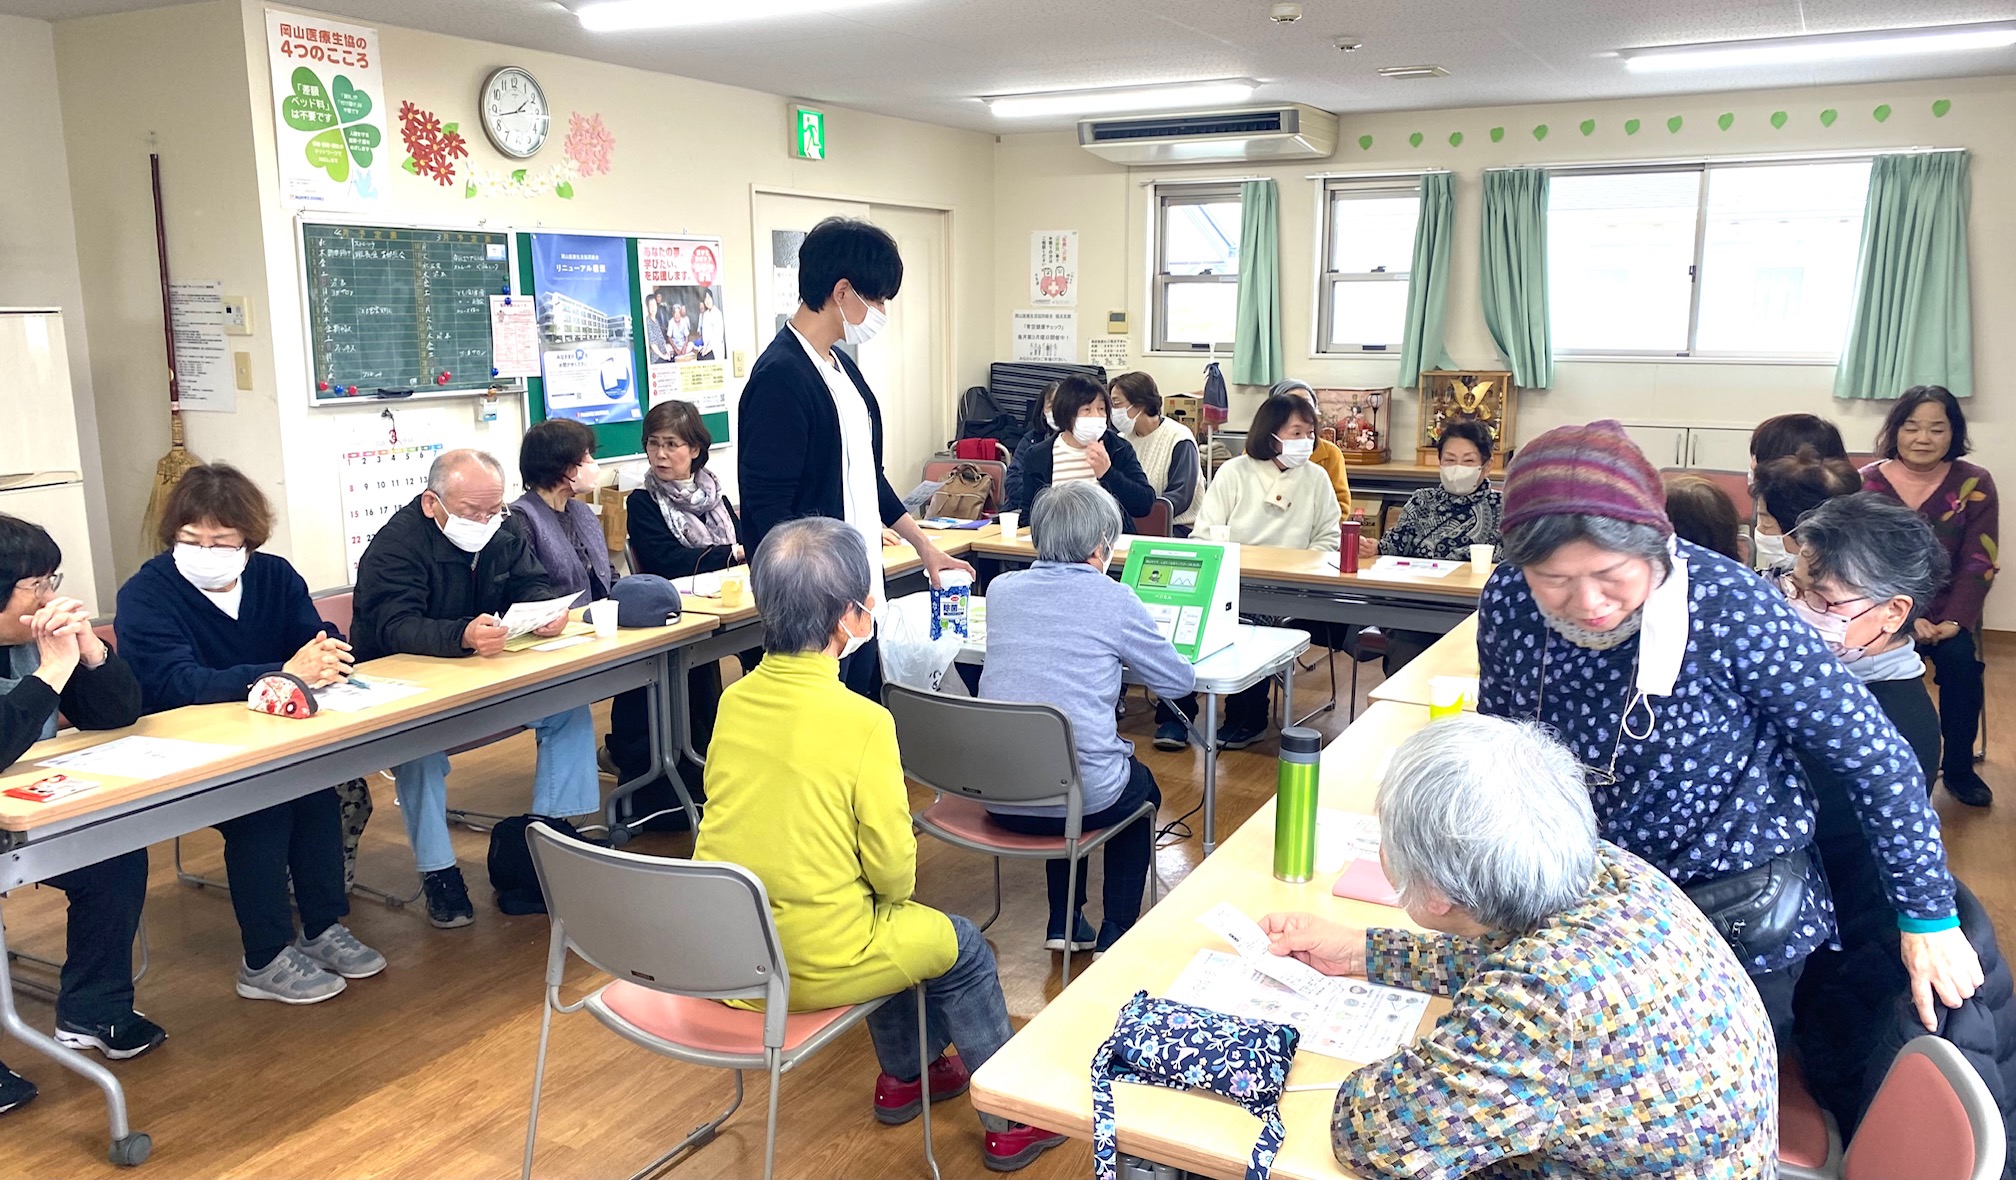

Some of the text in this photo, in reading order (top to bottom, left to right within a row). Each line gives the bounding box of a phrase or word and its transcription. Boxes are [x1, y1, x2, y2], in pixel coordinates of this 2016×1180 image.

[280, 24, 367, 50] 岡山医療生協の
[281, 40, 369, 69] 4つのこころ
[502, 80, 507, 91] 11
[511, 77, 518, 89] 12
[297, 83, 320, 97] 「差額
[494, 89, 500, 101] 10
[292, 97, 330, 111] ベッド料」
[531, 93, 536, 105] 2
[492, 104, 498, 114] 9
[291, 110, 332, 123] は不要です
[497, 119, 502, 131] 8
[533, 123, 537, 134] 4
[505, 131, 510, 142] 7
[644, 247, 683, 257] あなたの夢、
[644, 259, 677, 269] 学びたい、
[645, 271, 690, 281] を応援します。
[352, 536, 361, 544] 22
